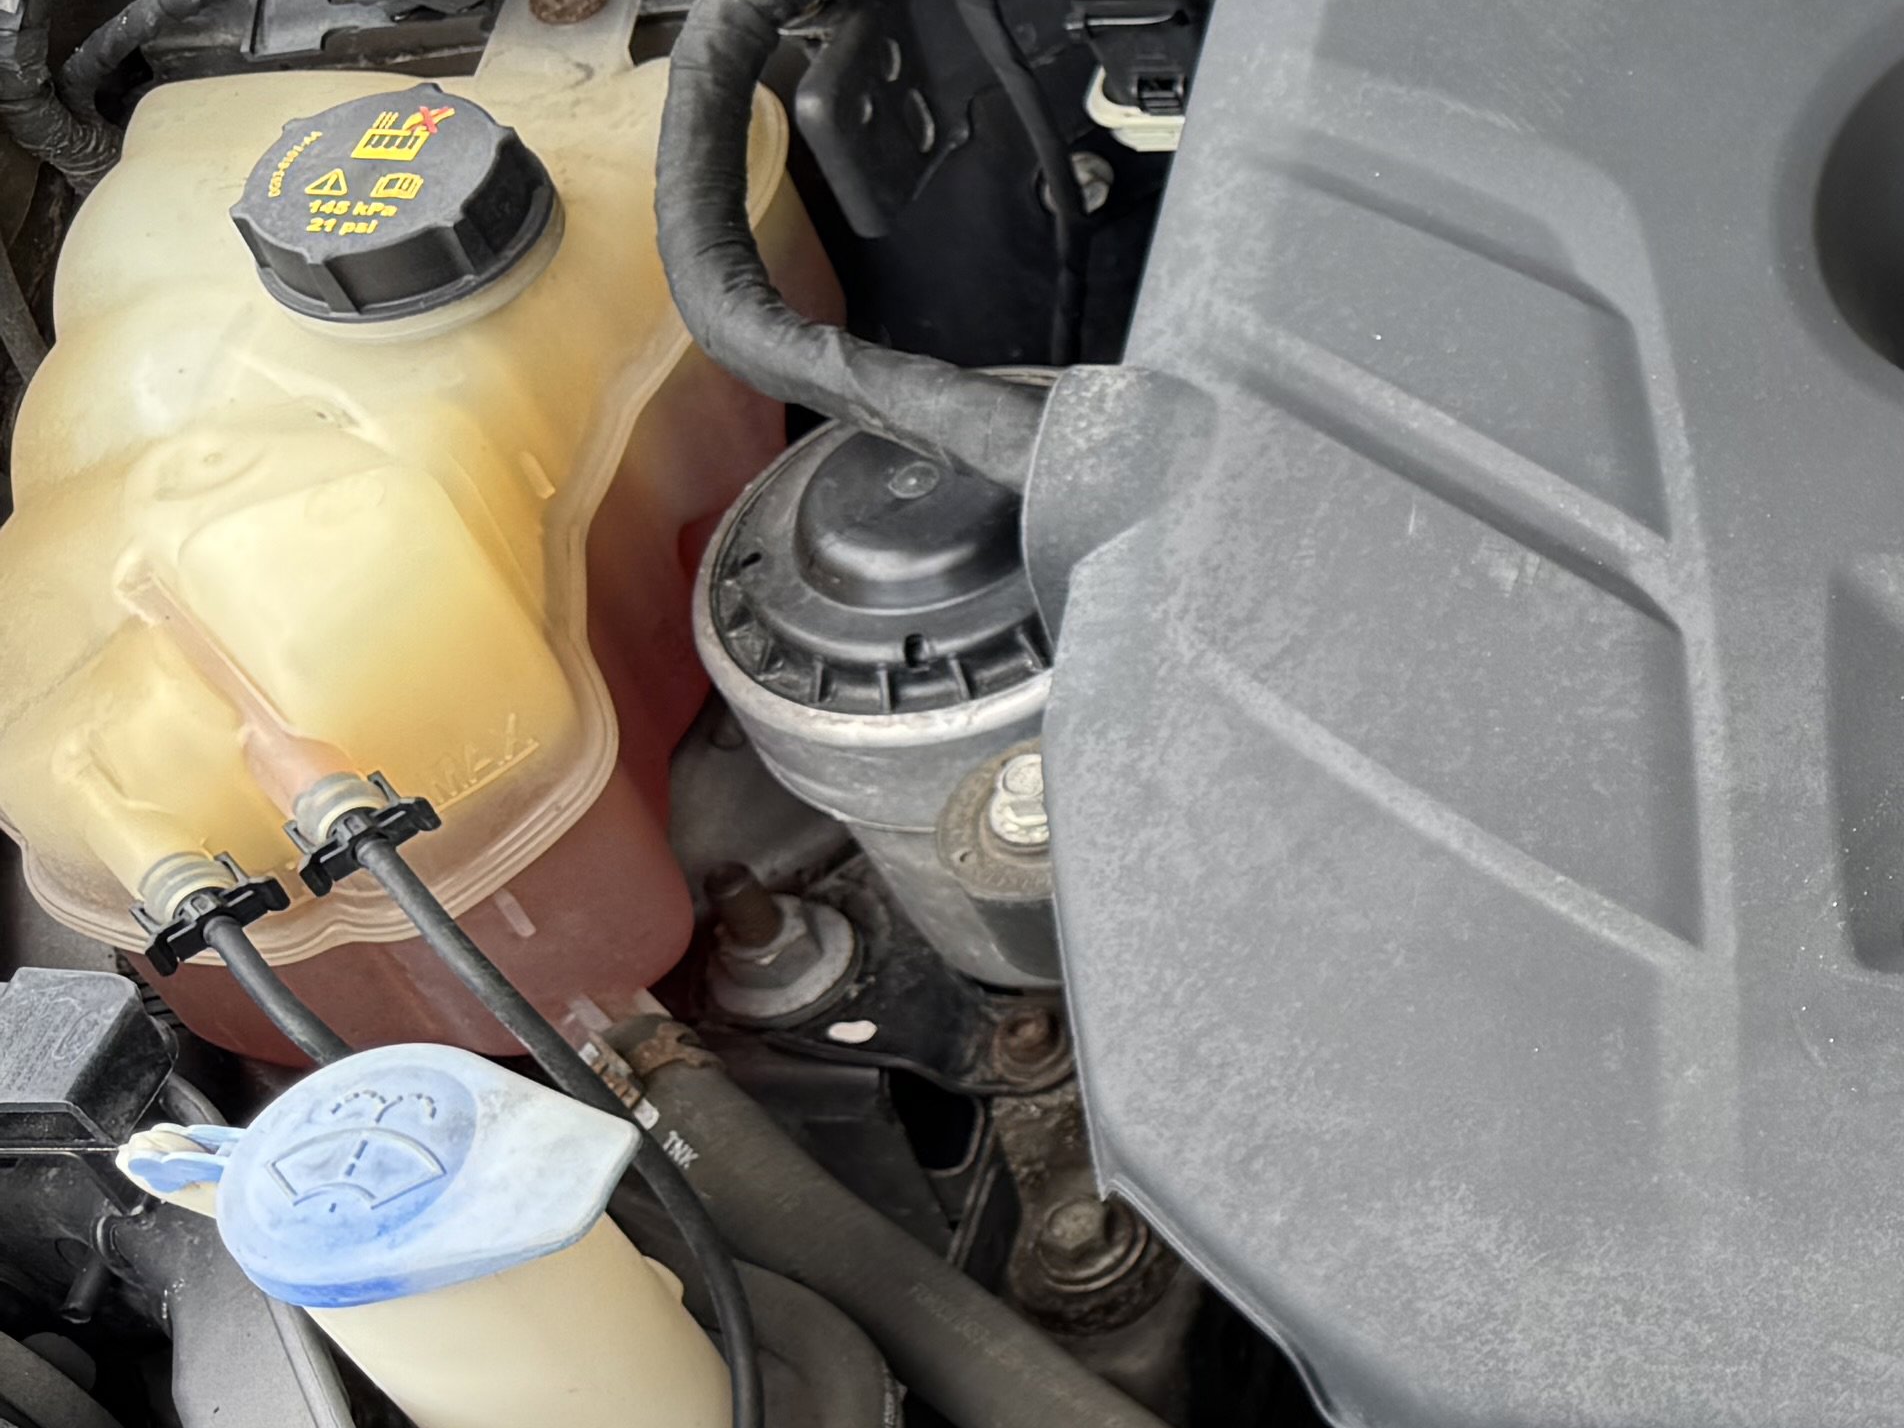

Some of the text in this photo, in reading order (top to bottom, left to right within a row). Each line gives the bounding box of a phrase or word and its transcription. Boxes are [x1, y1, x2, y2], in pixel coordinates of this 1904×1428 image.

[309, 199, 398, 217] 145 kPa
[306, 217, 378, 236] 21 psi
